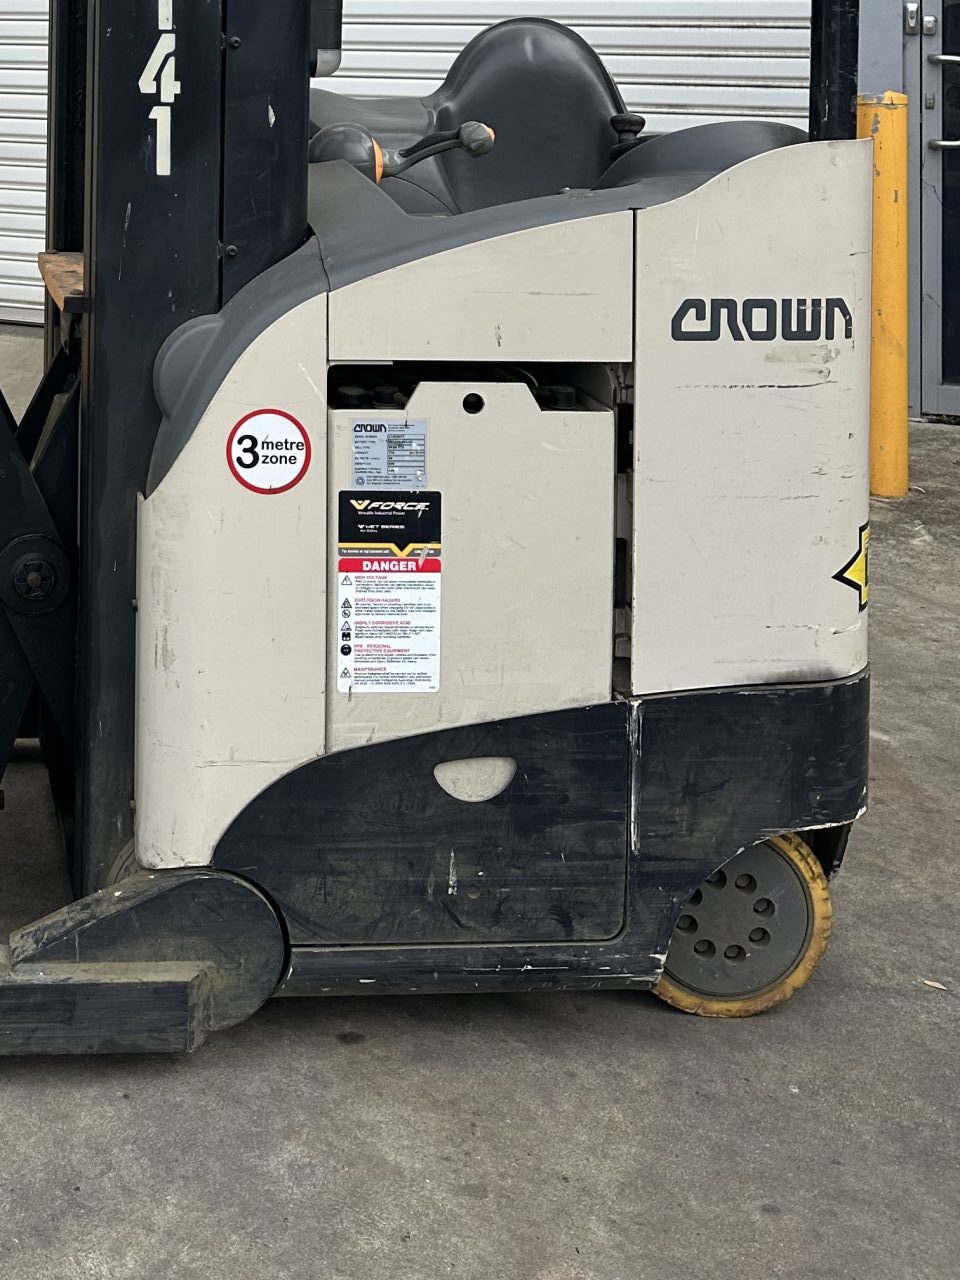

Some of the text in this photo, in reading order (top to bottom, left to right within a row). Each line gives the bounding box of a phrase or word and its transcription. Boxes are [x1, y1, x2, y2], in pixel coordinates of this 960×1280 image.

[671, 297, 853, 341] CROWN
[353, 424, 387, 432] CROWN
[236, 434, 305, 469] 3 metre
[261, 455, 297, 464] zone
[362, 561, 417, 571] DANGER
